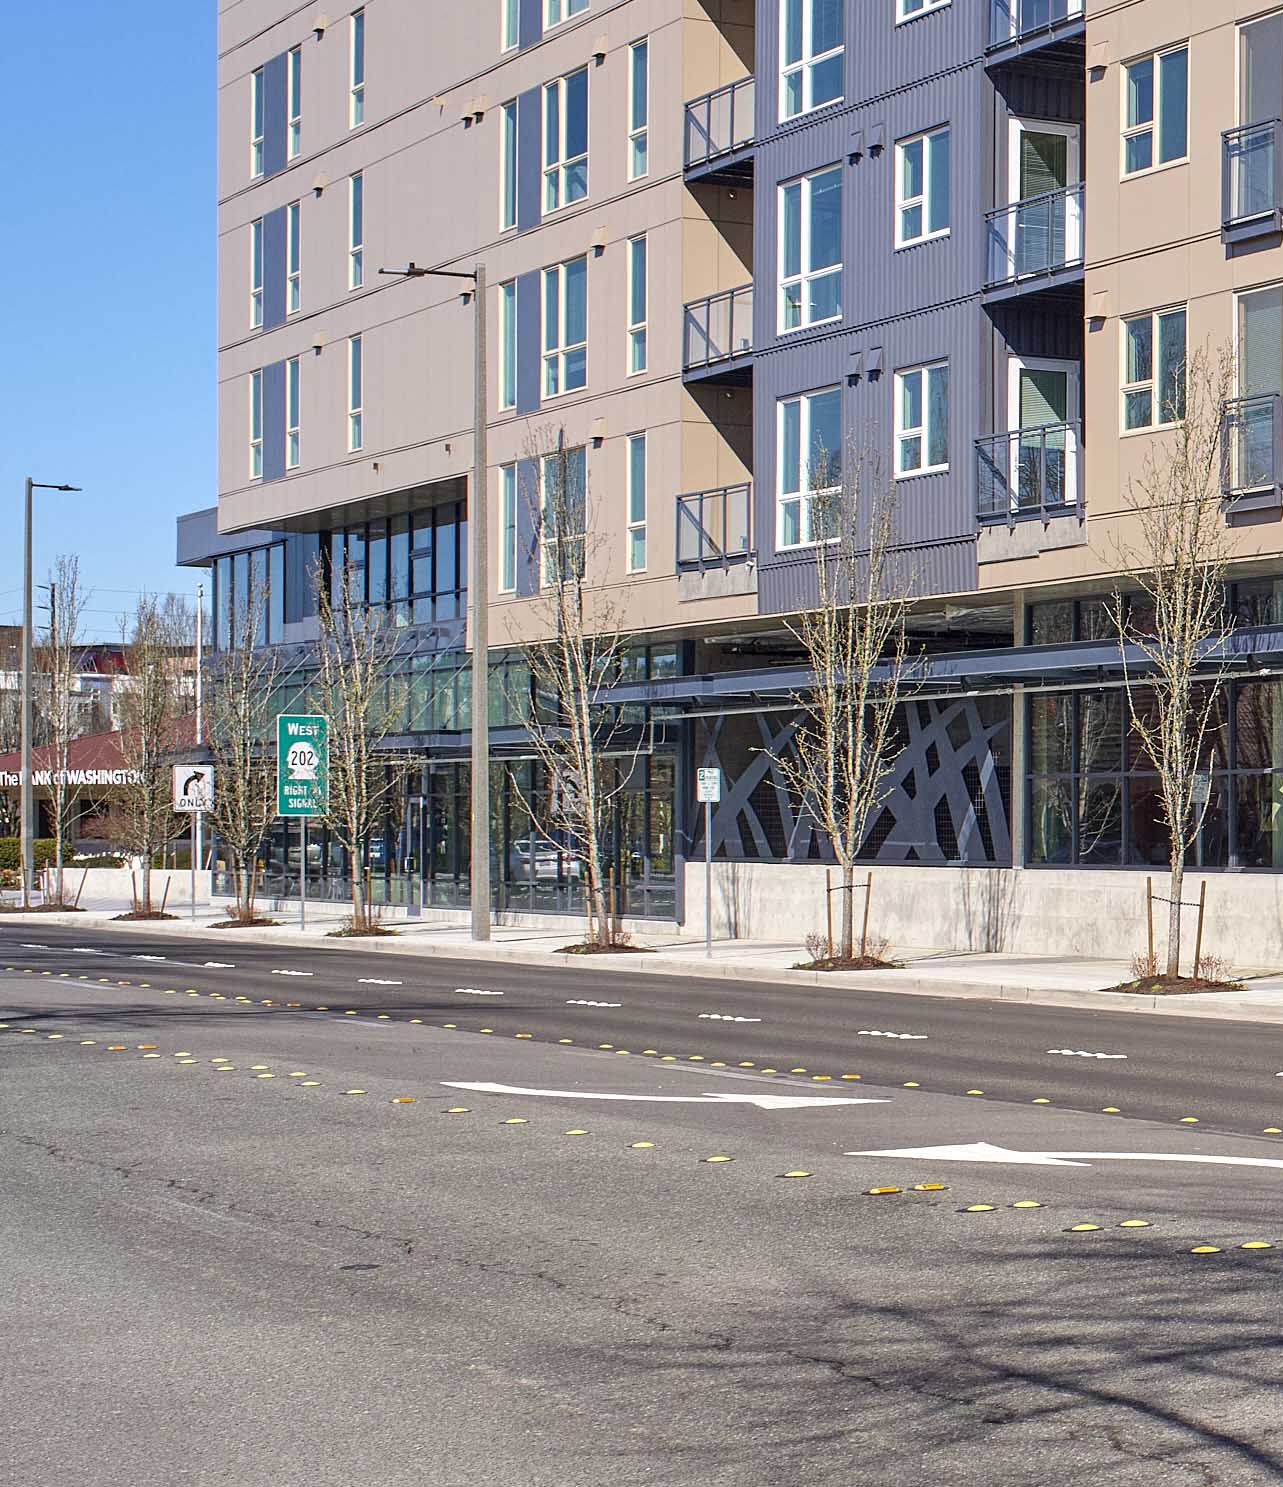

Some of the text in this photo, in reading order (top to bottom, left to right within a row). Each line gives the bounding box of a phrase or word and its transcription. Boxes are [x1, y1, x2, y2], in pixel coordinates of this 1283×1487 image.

[287, 722, 320, 736] WEST
[291, 750, 314, 766] 202
[0, 771, 18, 786] The
[284, 785, 307, 796] RIGHT
[180, 798, 207, 808] ONLY
[288, 798, 318, 809] SIGNAL
